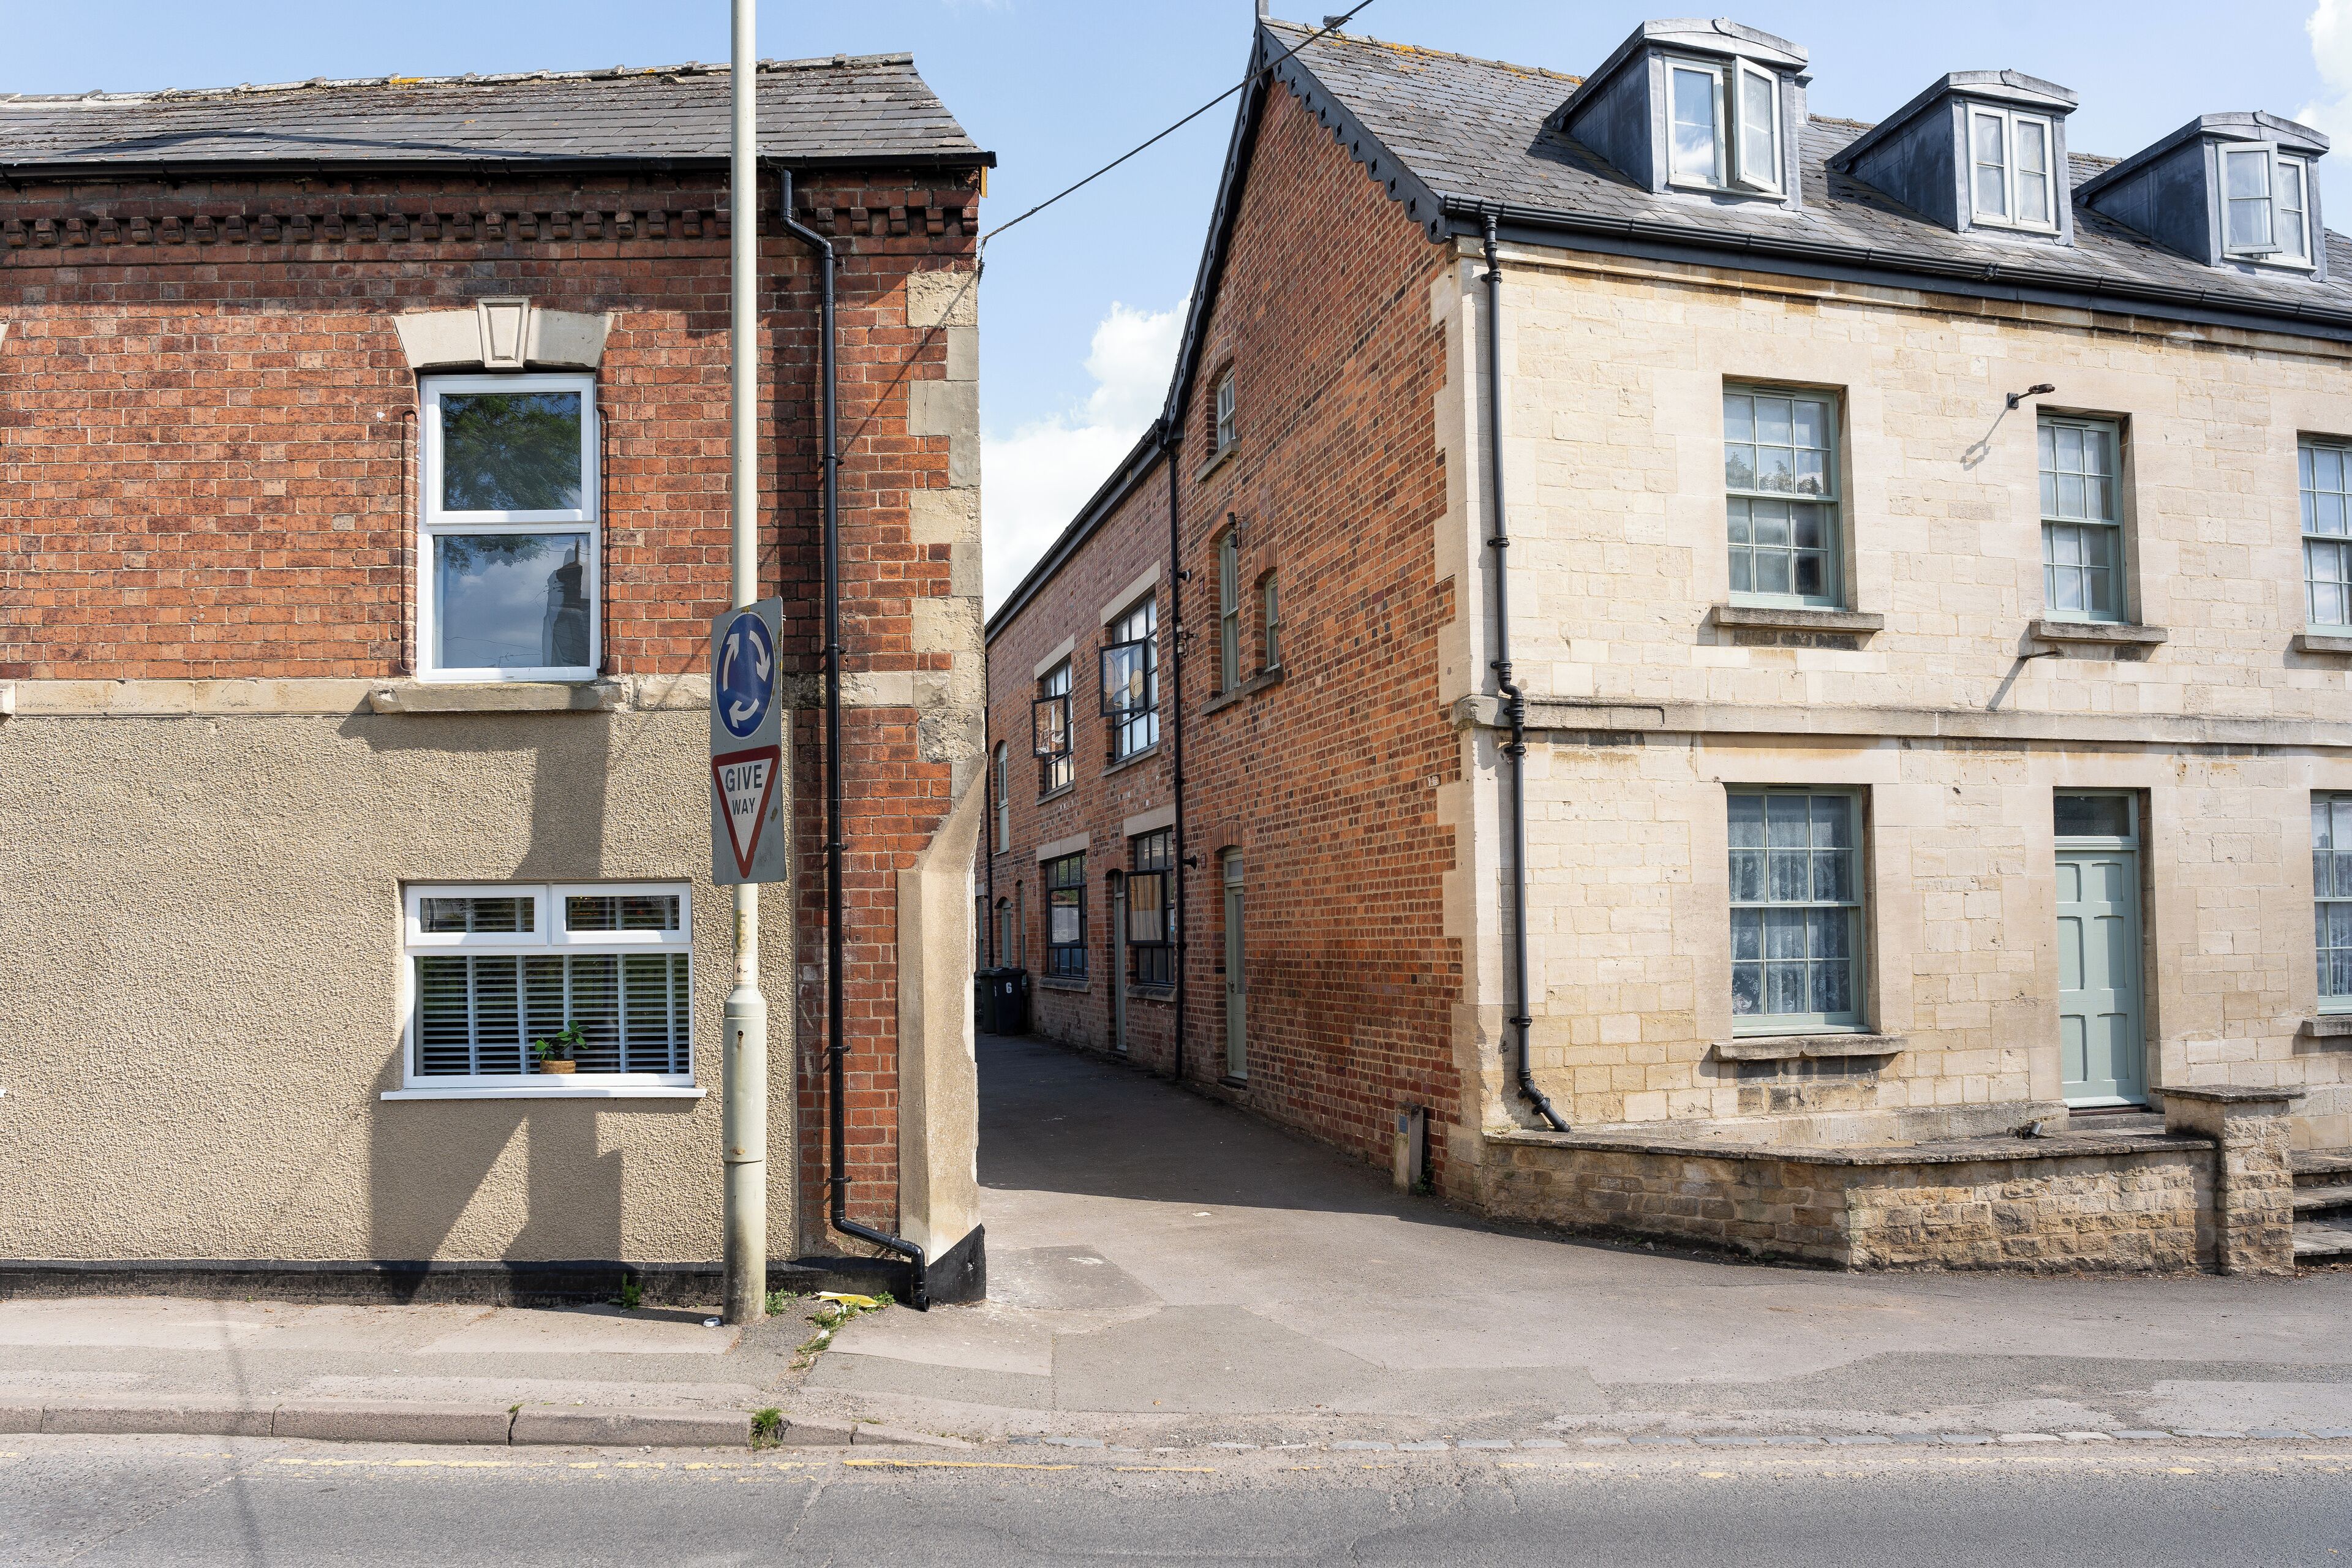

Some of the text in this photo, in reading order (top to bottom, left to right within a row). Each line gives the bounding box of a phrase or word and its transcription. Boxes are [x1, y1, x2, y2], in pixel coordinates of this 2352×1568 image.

[725, 764, 762, 792] GIVE
[732, 797, 755, 815] WAY
[1006, 982, 1012, 993] 6
